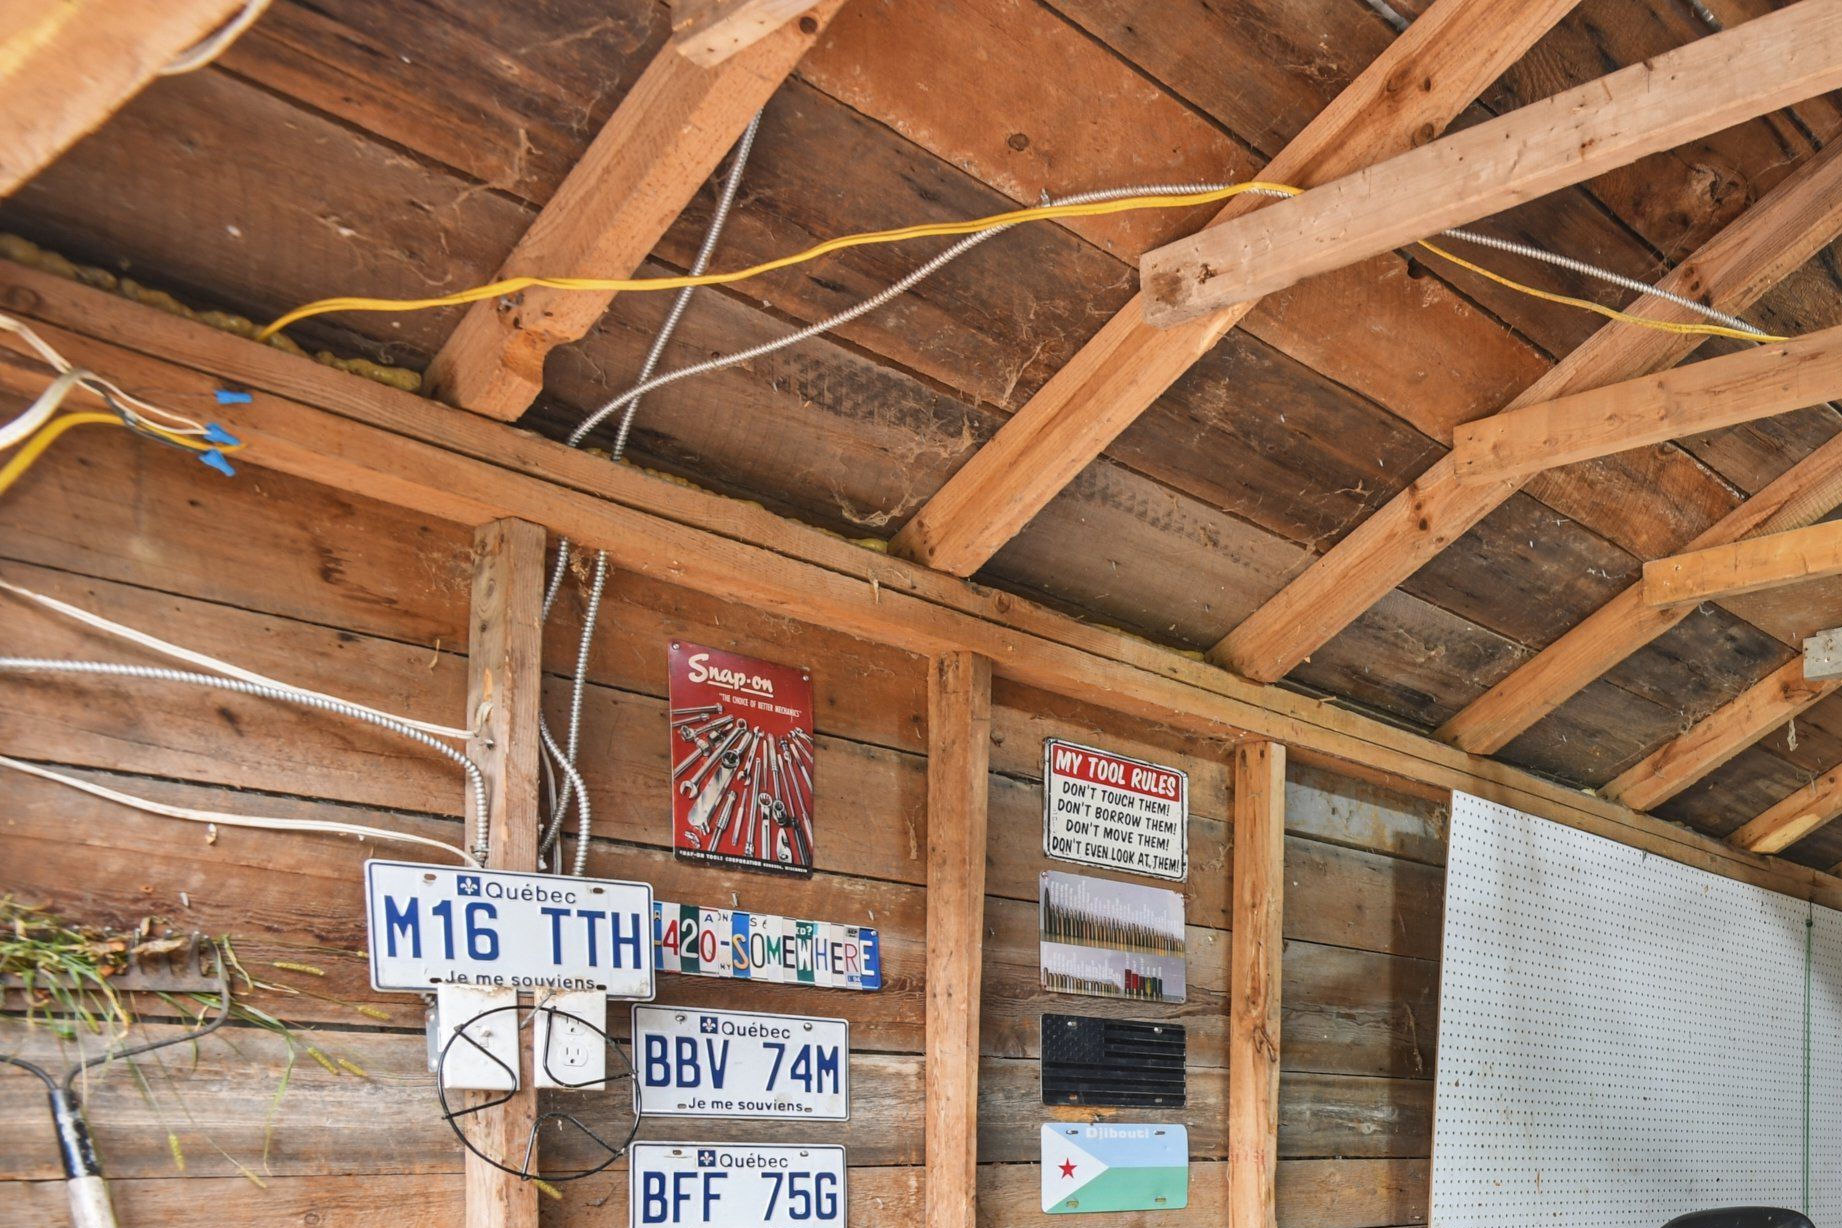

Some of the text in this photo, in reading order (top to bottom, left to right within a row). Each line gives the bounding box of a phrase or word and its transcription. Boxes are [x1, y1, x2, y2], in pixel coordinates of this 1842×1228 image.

[688, 653, 774, 693] Snap-on
[732, 696, 749, 707] CHOICE
[749, 699, 757, 708] OF
[758, 701, 773, 712] BETTER
[1056, 749, 1176, 797] MY TOOL RULES
[1062, 781, 1170, 816] DON'T TOUCH THEM!
[1057, 798, 1177, 835] DON'T BORROW THEM!
[1065, 819, 1169, 851] DON'T MOVE THEM!
[706, 852, 723, 861] TOOLS
[1052, 836, 1179, 873] DON'T EVEN LOOK AT THEM!
[485, 882, 577, 905] Québec
[384, 895, 642, 970] M16 TTH
[445, 971, 596, 990] Je me souviens
[721, 1021, 791, 1039] Québec
[645, 1034, 839, 1094] BBV 74M
[688, 1097, 803, 1112] Je me souviens
[1086, 1127, 1149, 1140] Djibouti
[719, 1152, 789, 1168] Québec
[642, 1171, 838, 1224] BFF 75G
